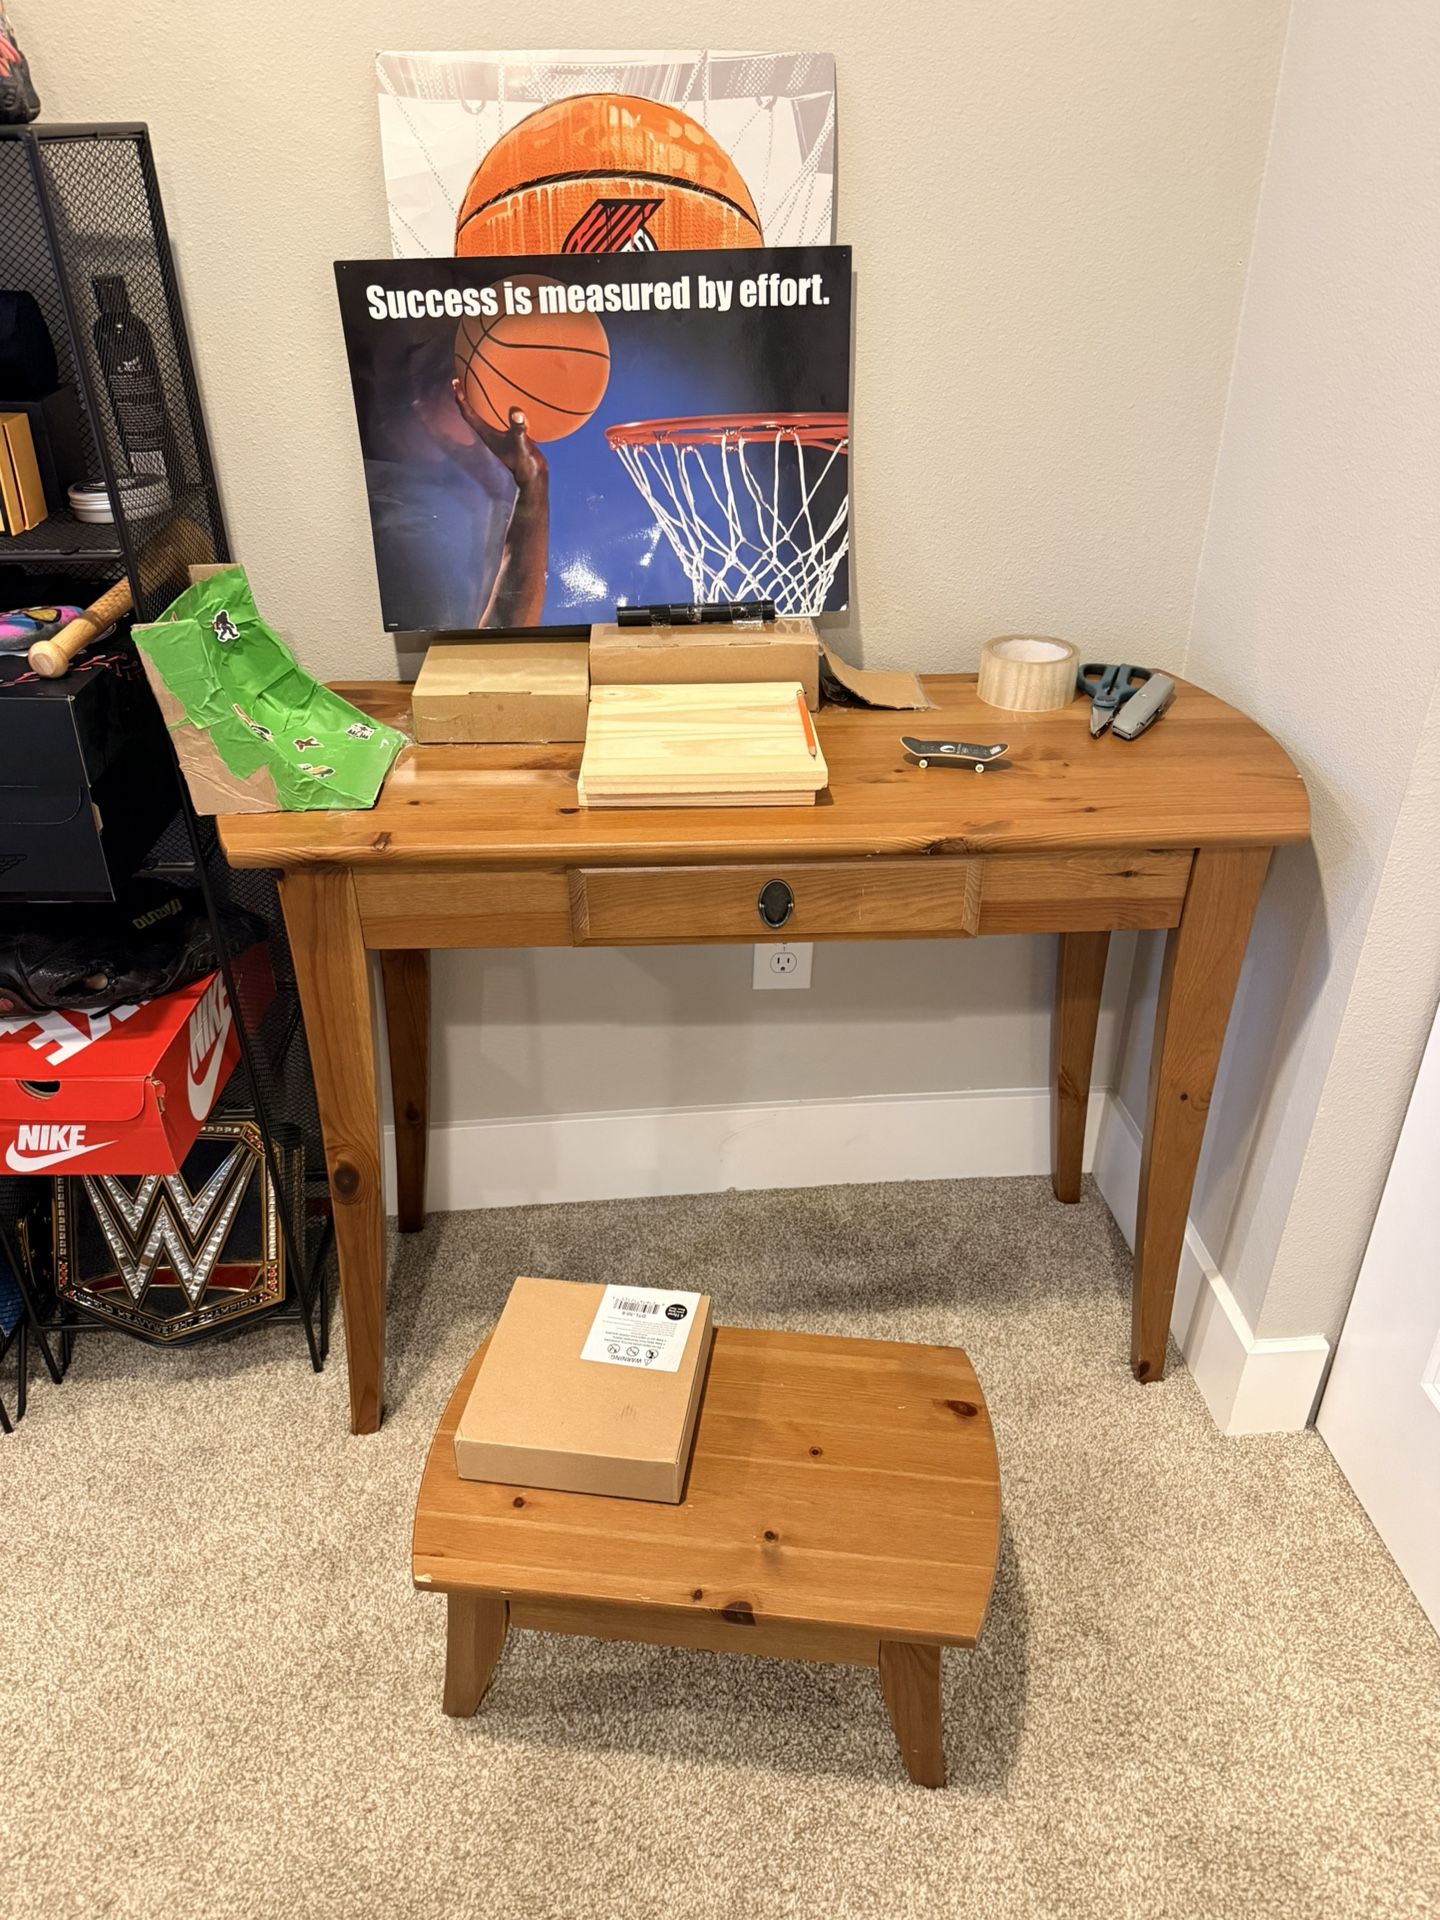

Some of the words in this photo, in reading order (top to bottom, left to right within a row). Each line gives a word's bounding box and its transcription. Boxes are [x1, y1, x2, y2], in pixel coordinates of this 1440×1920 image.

[366, 284, 499, 320] Success
[503, 281, 533, 315] is
[538, 275, 691, 314] measured
[698, 275, 733, 312] by
[739, 273, 831, 308] effort.
[17, 1124, 87, 1151] NIKE
